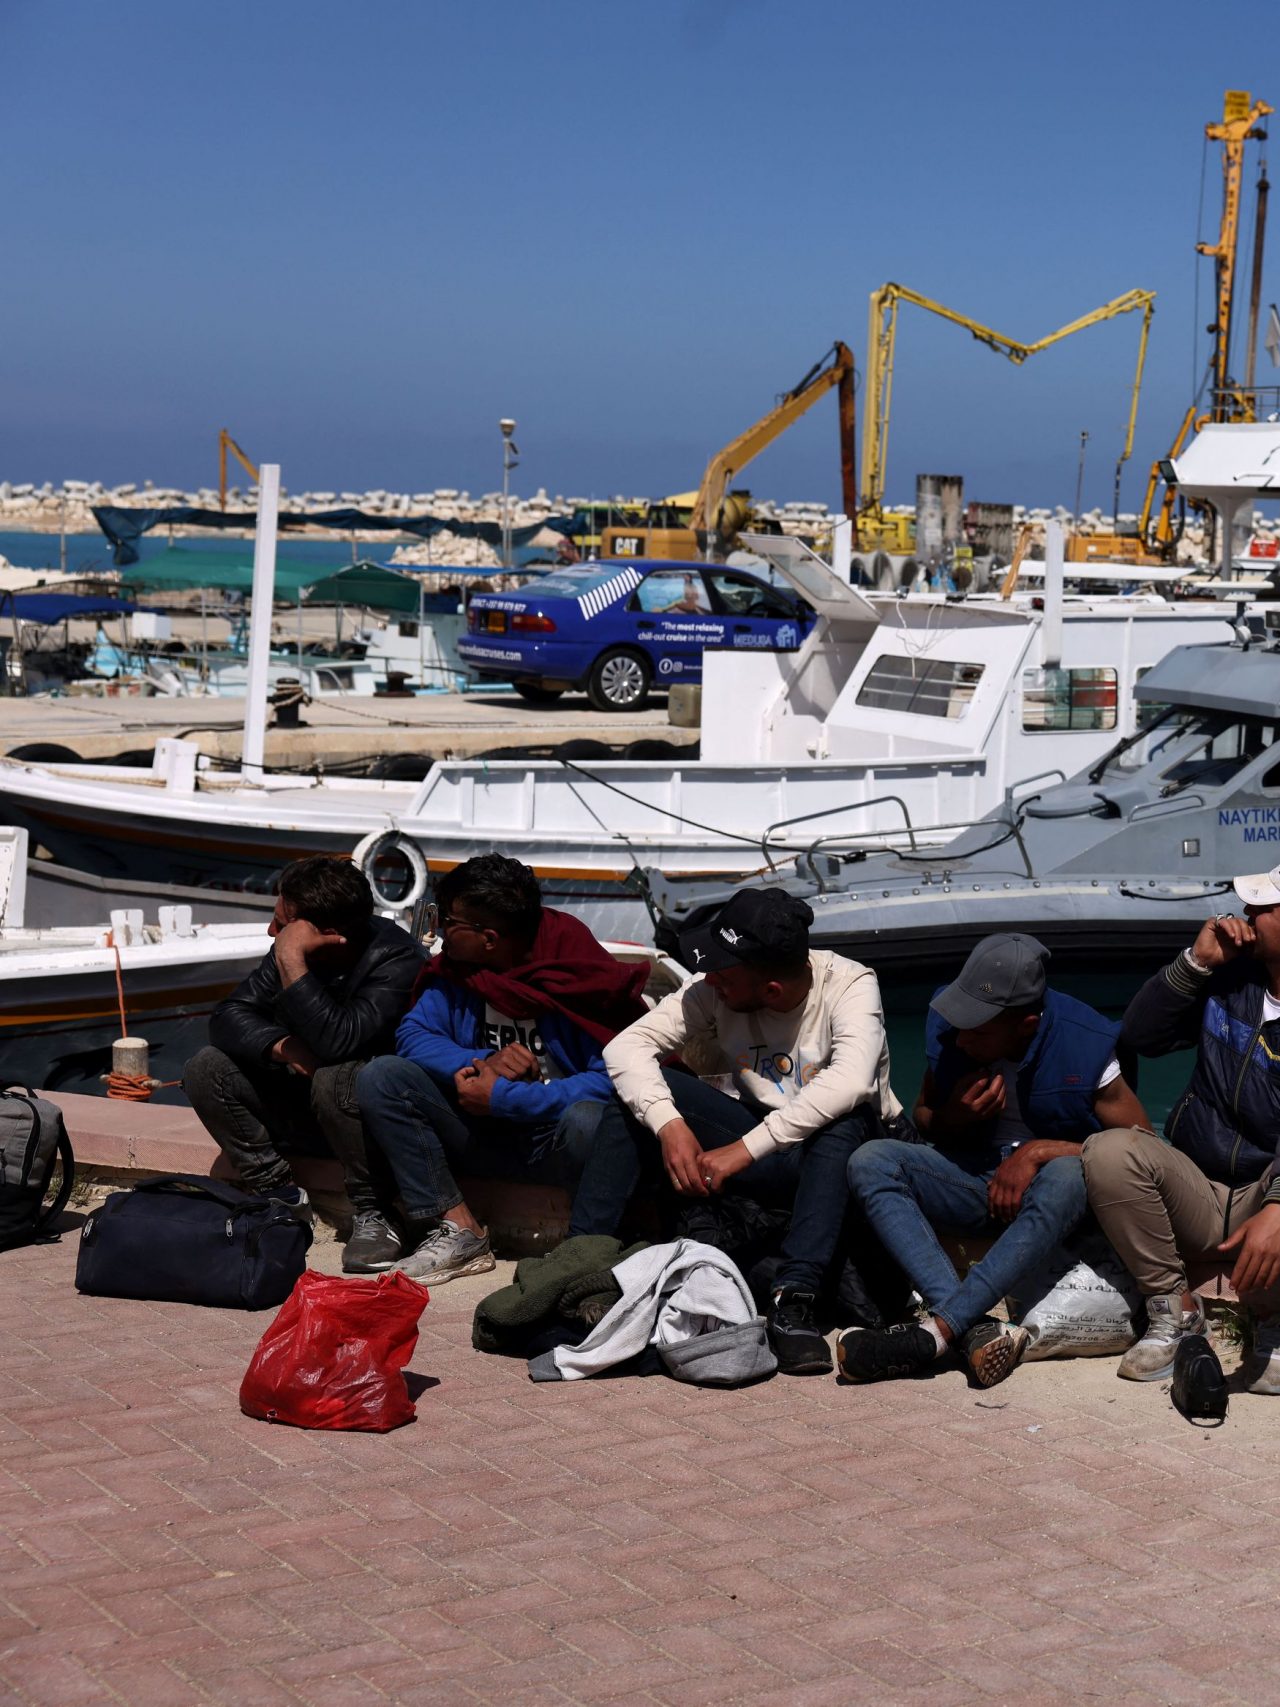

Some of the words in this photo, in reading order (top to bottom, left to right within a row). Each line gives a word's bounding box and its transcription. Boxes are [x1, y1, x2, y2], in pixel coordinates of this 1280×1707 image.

[615, 537, 638, 555] CAT
[695, 622, 725, 635] relaxing
[666, 633, 688, 642] cruise
